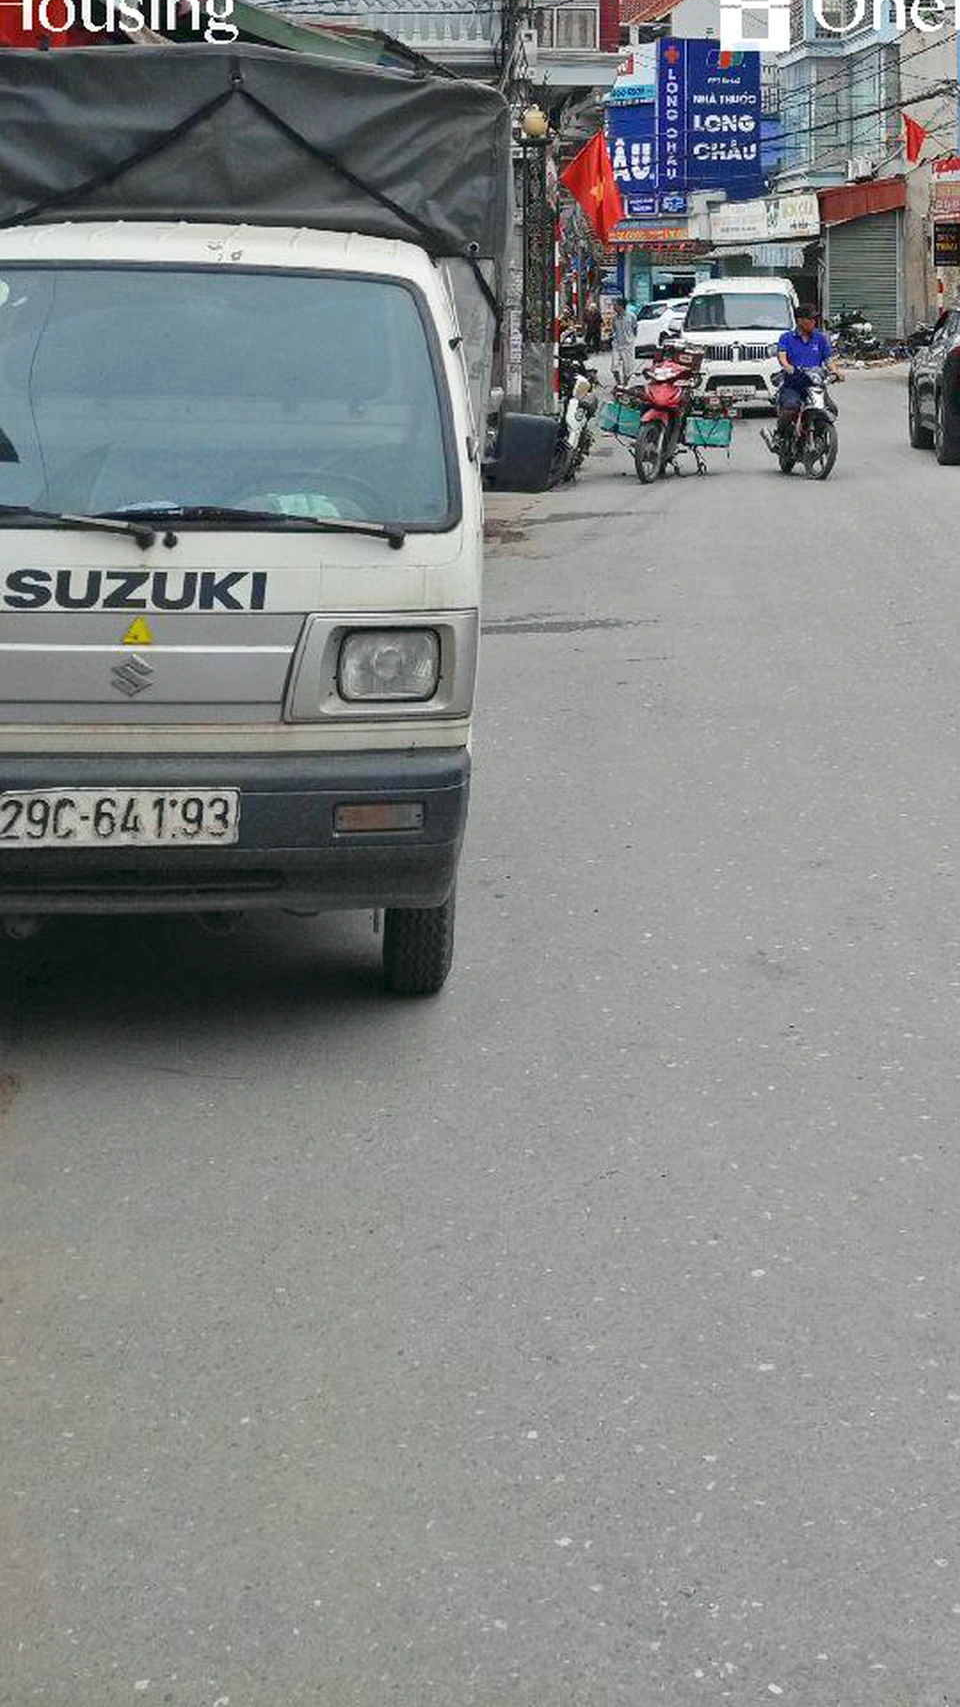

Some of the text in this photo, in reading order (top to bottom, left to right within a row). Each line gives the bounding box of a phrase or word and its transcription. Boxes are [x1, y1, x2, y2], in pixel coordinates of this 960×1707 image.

[693, 114, 756, 133] LONG
[693, 140, 757, 161] CHÂU
[3, 569, 268, 611] SUZUKI
